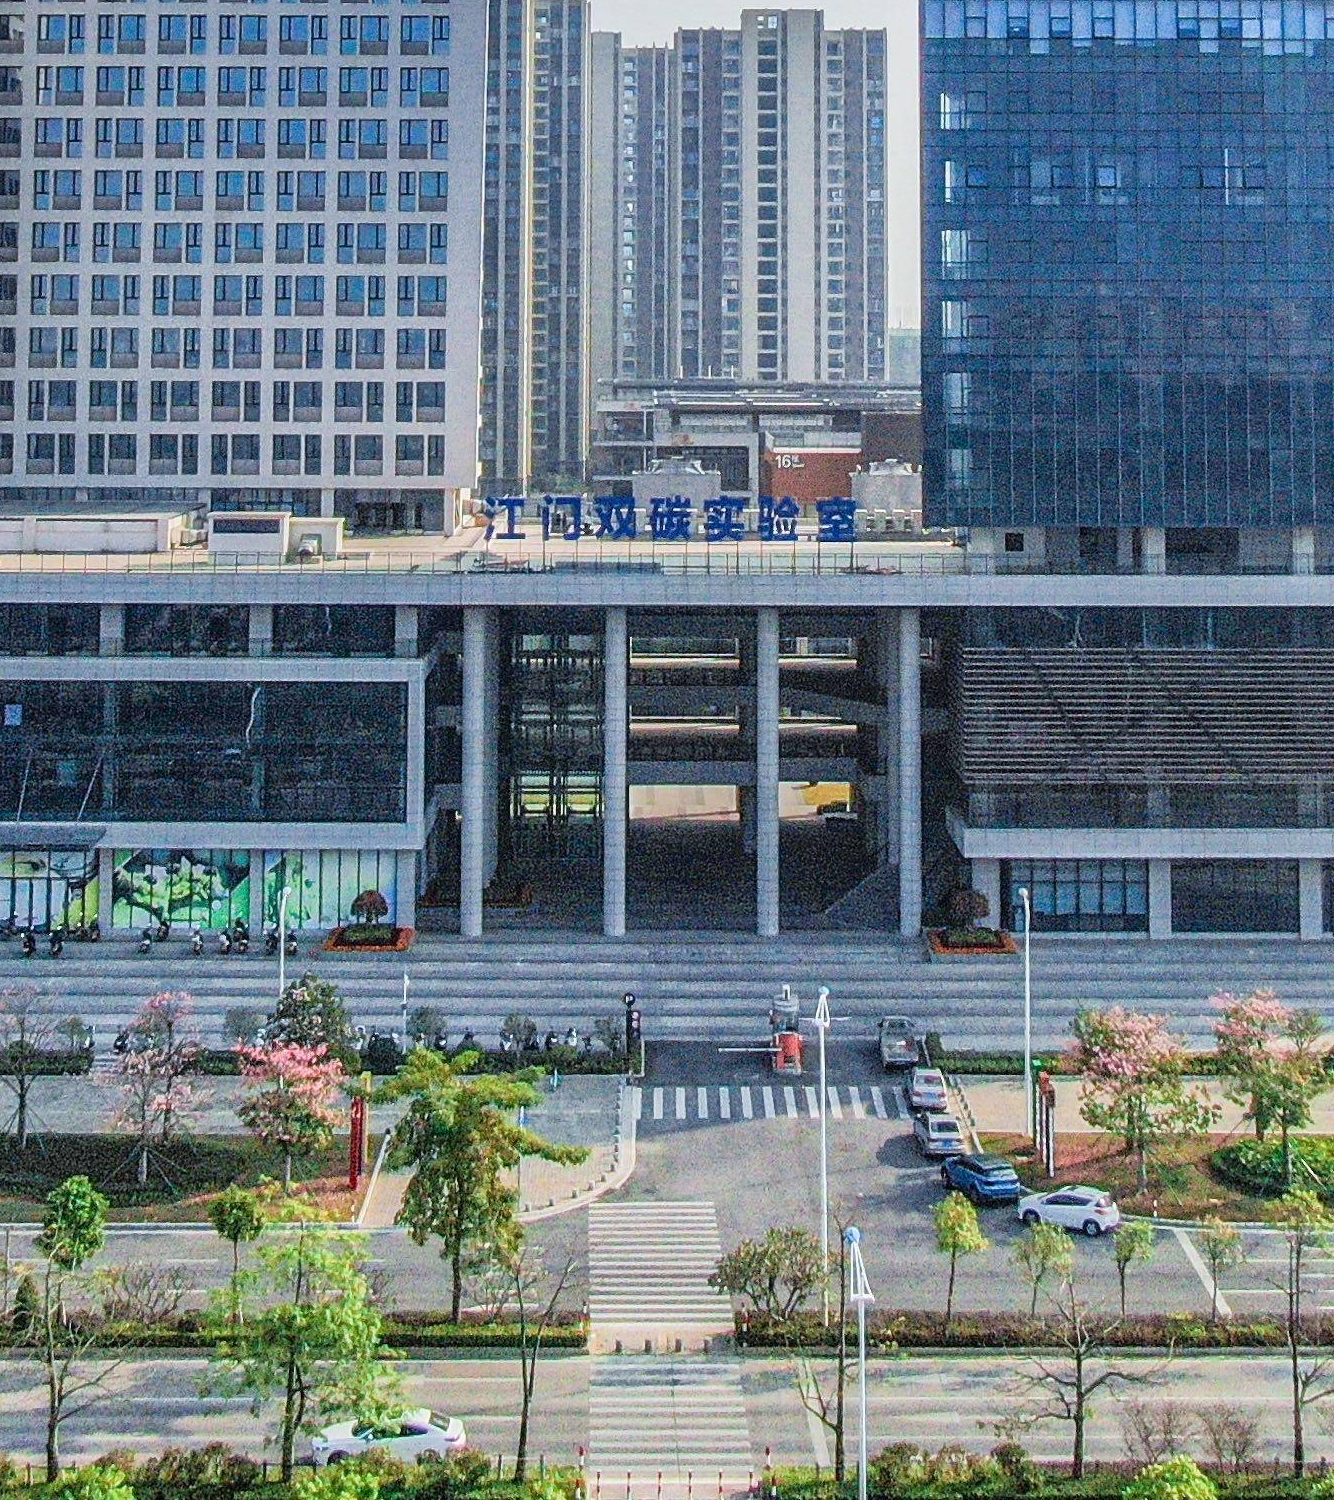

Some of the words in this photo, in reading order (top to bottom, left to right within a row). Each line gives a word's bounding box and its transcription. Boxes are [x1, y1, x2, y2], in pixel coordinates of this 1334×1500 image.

[484, 494, 857, 542] 江门双碳实验室
